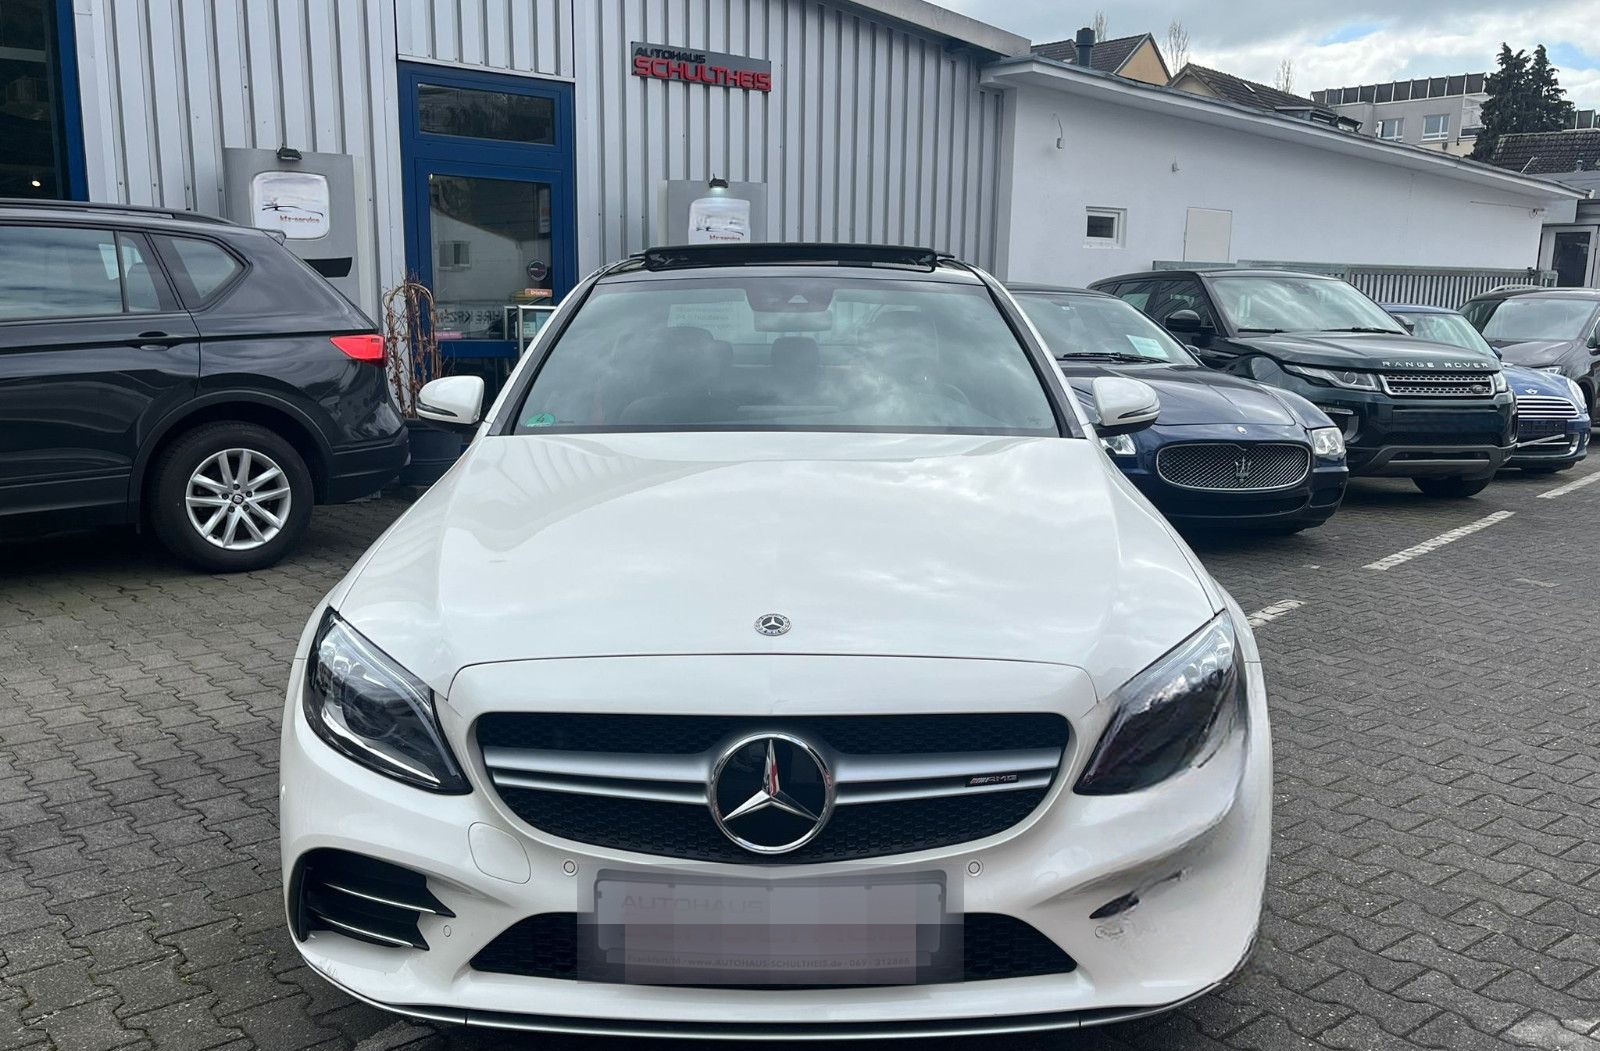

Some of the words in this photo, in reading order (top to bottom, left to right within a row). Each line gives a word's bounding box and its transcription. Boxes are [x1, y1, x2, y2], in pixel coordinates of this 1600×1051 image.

[635, 47, 705, 64] AUTOHAUS
[634, 57, 772, 91] SCHULTHEIS
[620, 895, 764, 914] AUTOHAUS
[627, 954, 681, 965] Frankfurt/M
[688, 957, 842, 968] www.AUTOHAUS-SCHULTHEIS.de
[849, 958, 867, 966] 069
